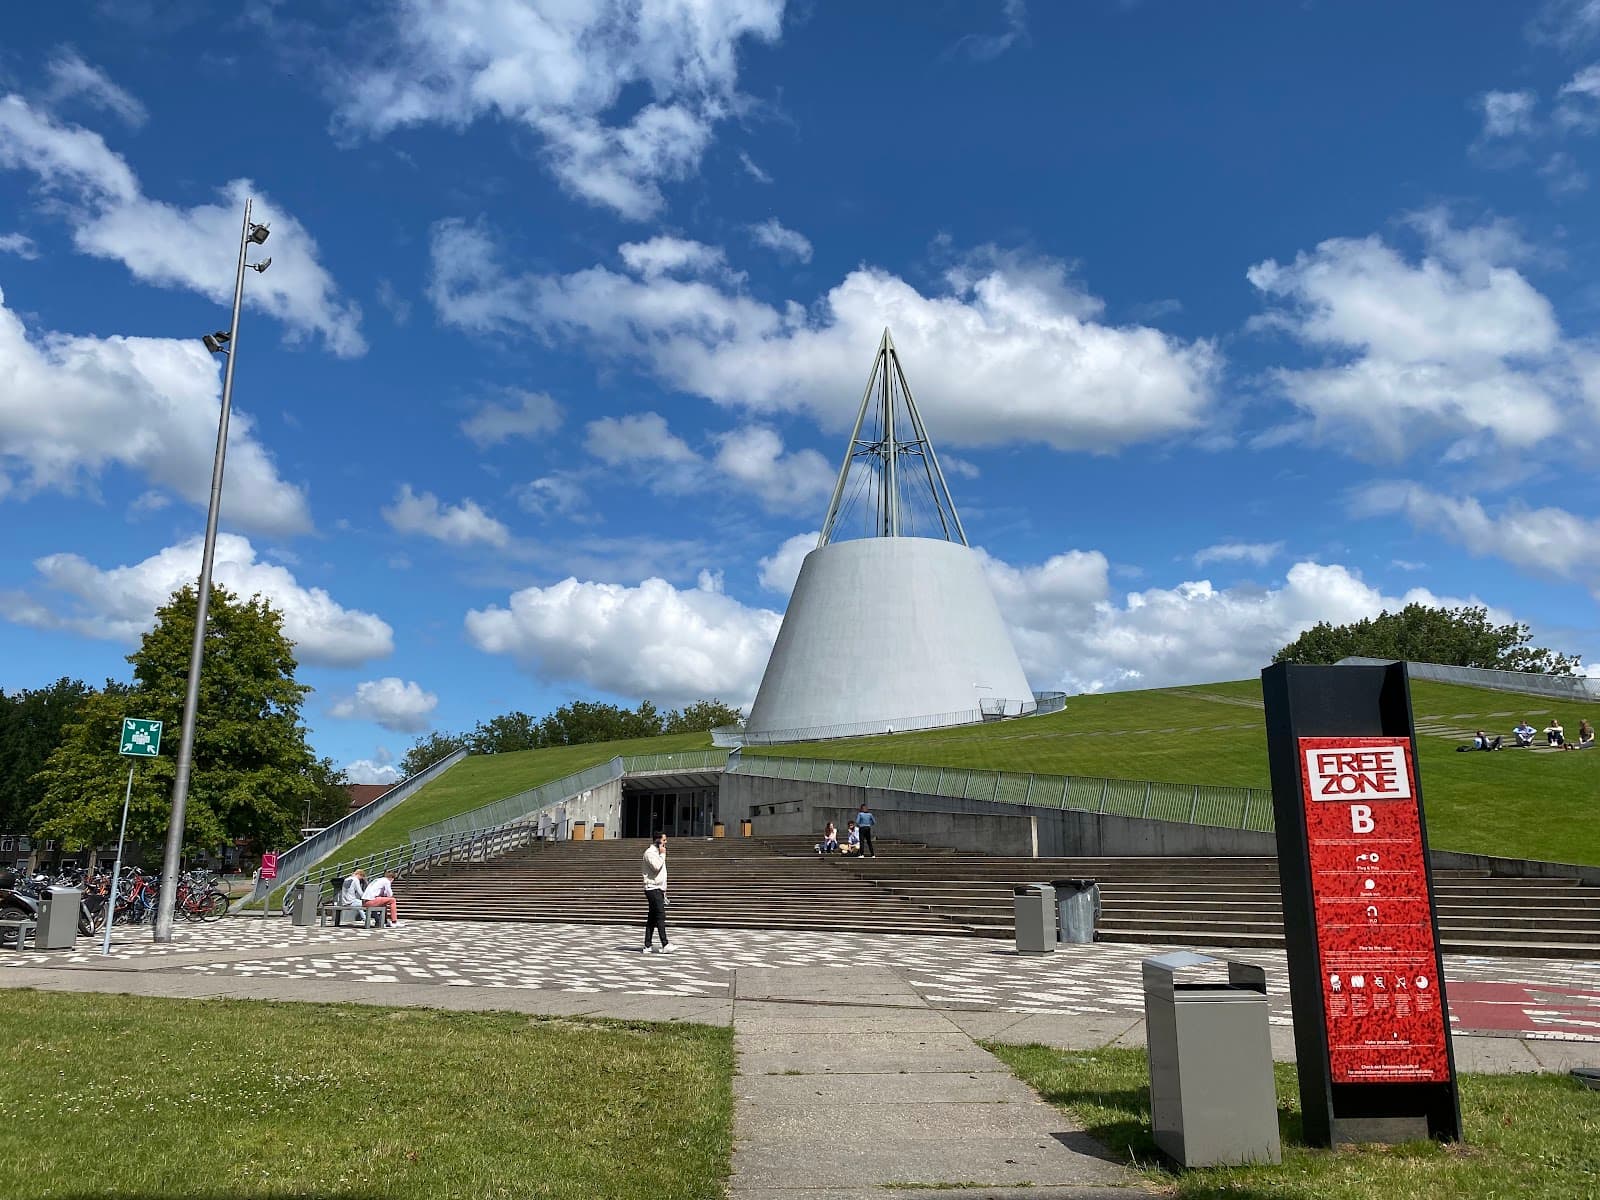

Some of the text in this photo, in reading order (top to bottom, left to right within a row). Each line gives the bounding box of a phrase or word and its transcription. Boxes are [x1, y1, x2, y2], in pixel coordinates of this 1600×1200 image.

[1317, 752, 1397, 773] FREE
[1320, 772, 1400, 794] ZONE
[1350, 804, 1375, 834] B
